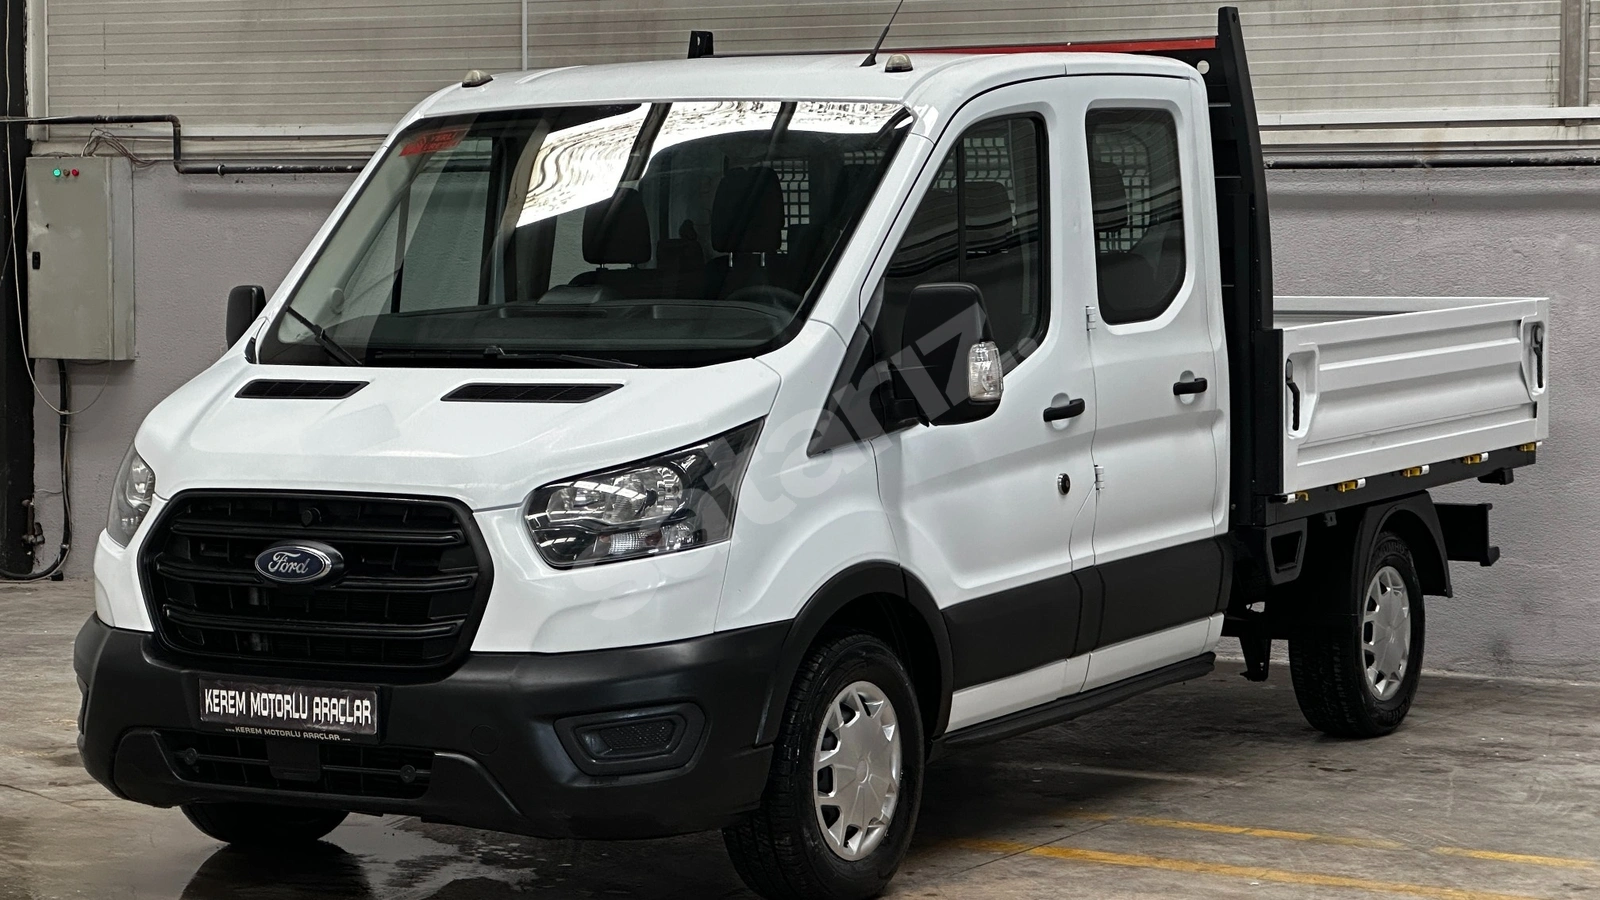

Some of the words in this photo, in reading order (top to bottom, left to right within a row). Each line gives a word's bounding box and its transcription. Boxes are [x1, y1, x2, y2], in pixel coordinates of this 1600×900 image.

[268, 551, 311, 574] Ford
[205, 688, 246, 717] KEREM
[250, 691, 308, 721] MOTORLU
[312, 695, 371, 726] ARAÇLAR
[263, 728, 301, 738] MOTORLU
